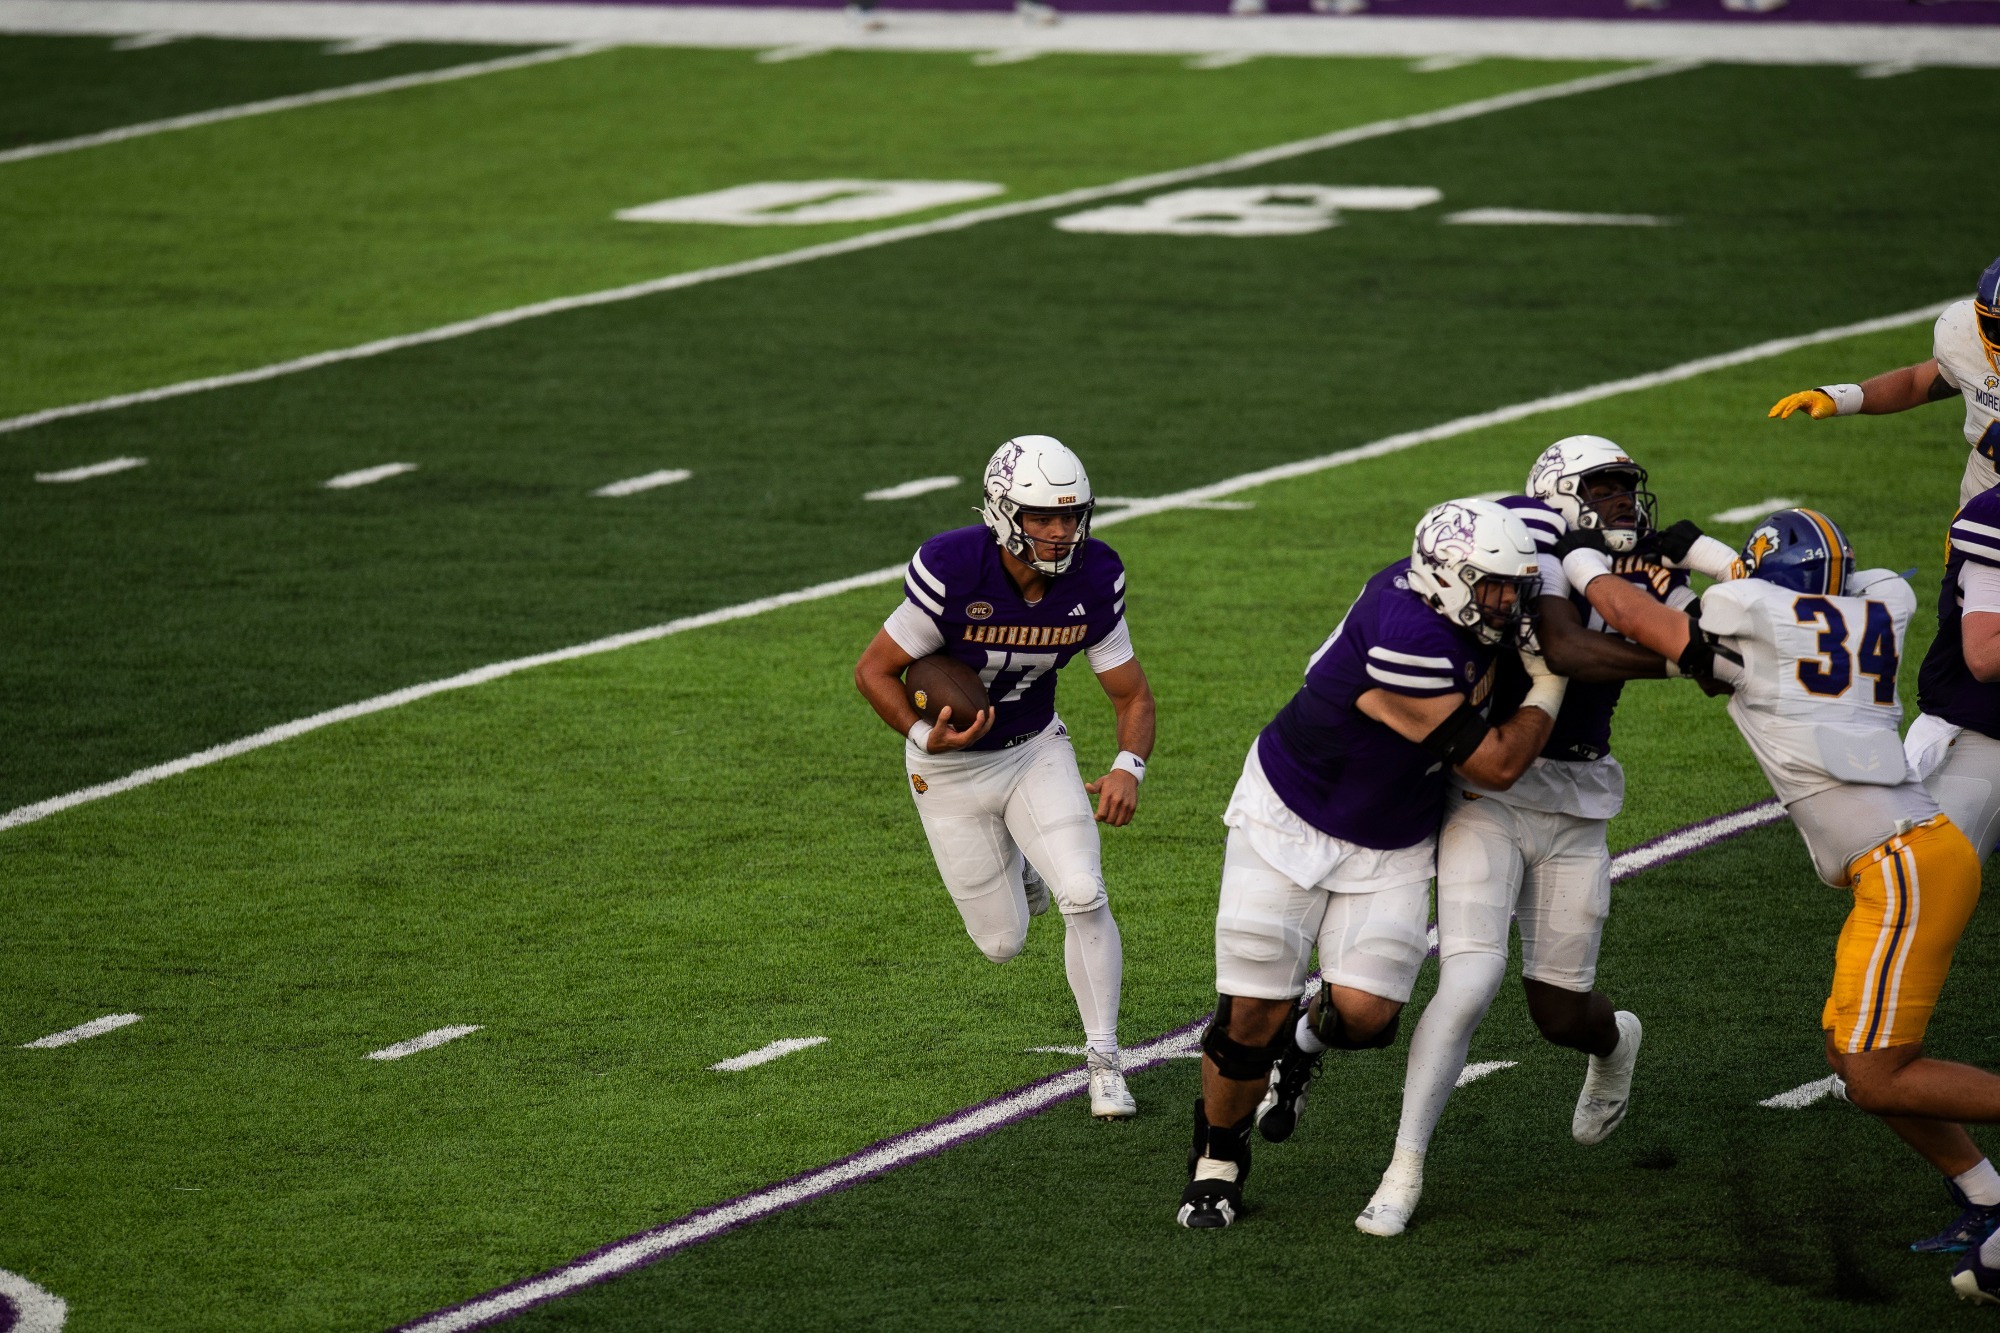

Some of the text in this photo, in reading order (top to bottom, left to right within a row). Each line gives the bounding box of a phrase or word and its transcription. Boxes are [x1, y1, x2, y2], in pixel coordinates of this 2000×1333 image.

[1976, 388, 2000, 412] MORE
[1058, 496, 1077, 505] NECKS
[1804, 547, 1825, 560] 34
[971, 607, 987, 615] OVC
[962, 624, 1088, 646] LEATHERNECKS
[1792, 594, 1899, 706] 34
[978, 650, 1059, 702] 17
